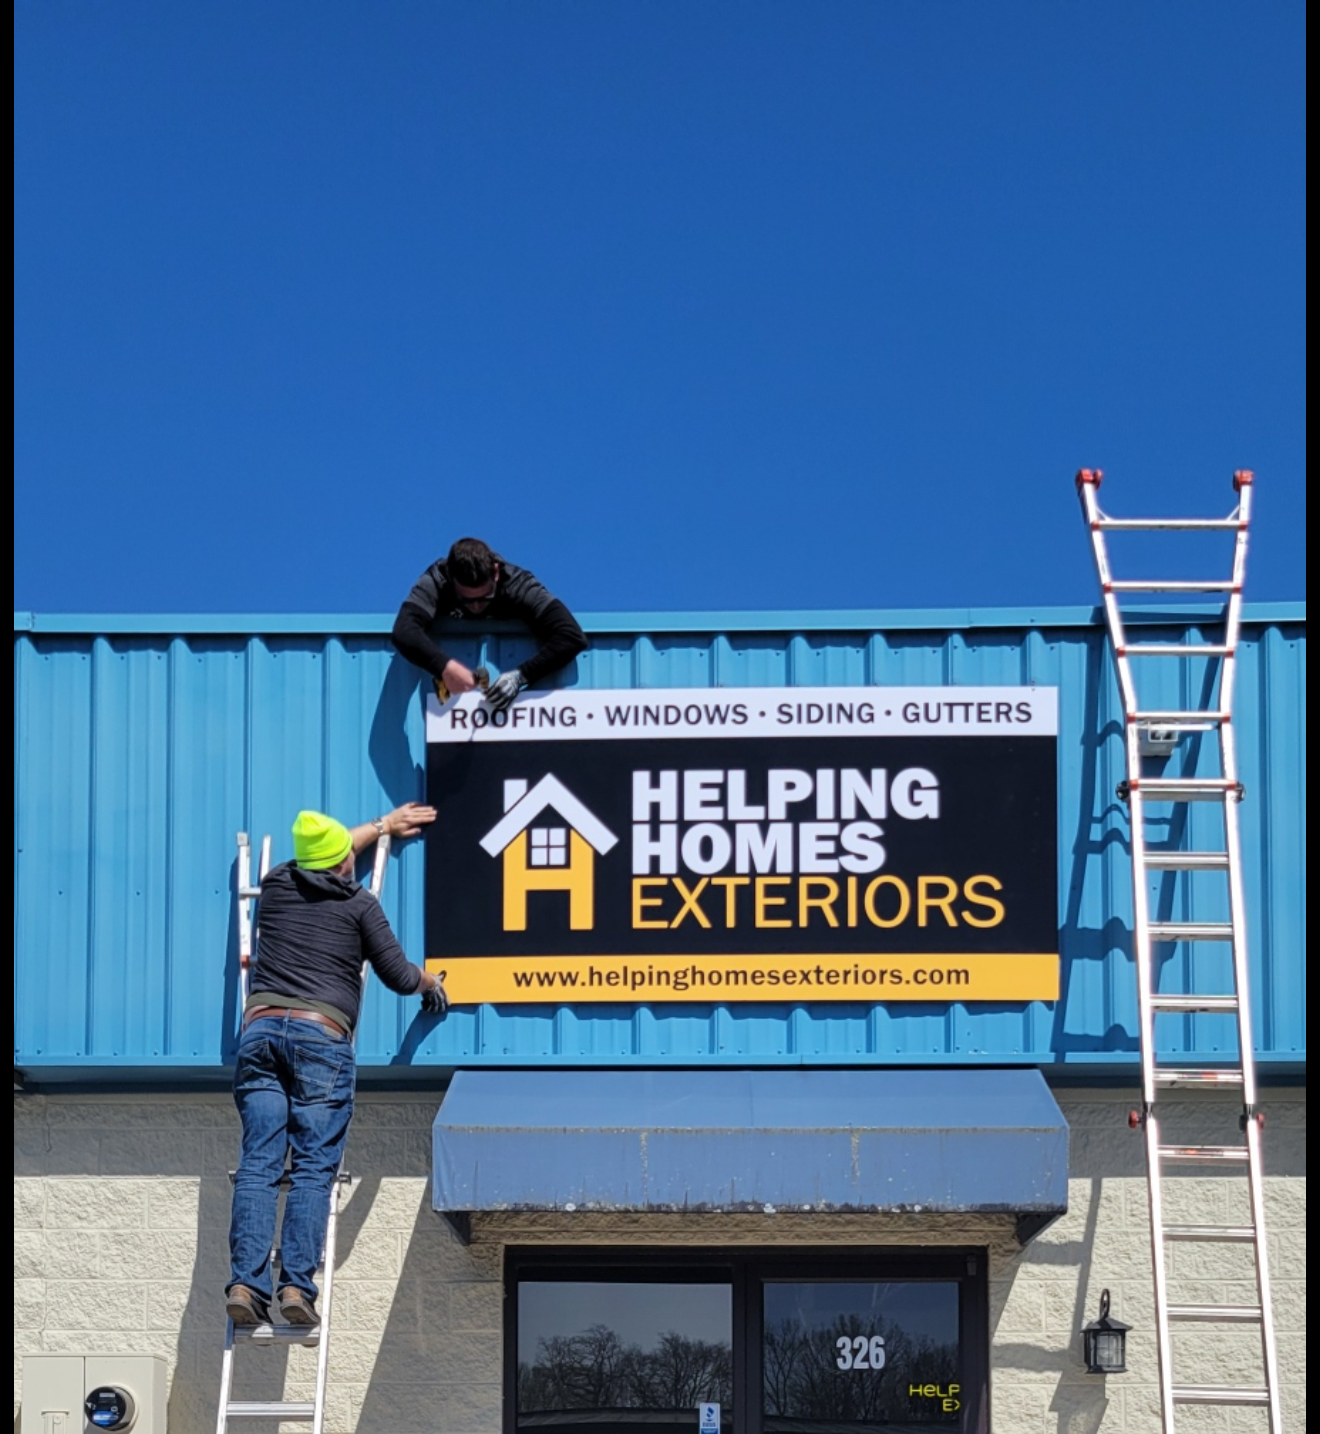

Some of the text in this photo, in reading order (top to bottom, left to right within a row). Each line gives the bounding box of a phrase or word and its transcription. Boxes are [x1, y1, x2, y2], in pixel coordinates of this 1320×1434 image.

[450, 701, 1033, 729] ROOFING WINDOWS SIDING GUTTERS
[632, 767, 940, 823] HELPING
[632, 822, 886, 875] HOMES
[632, 874, 1006, 930] EXTERIORS
[513, 964, 970, 991] www.helpinghomesexteriors.com
[836, 1335, 886, 1370] 326
